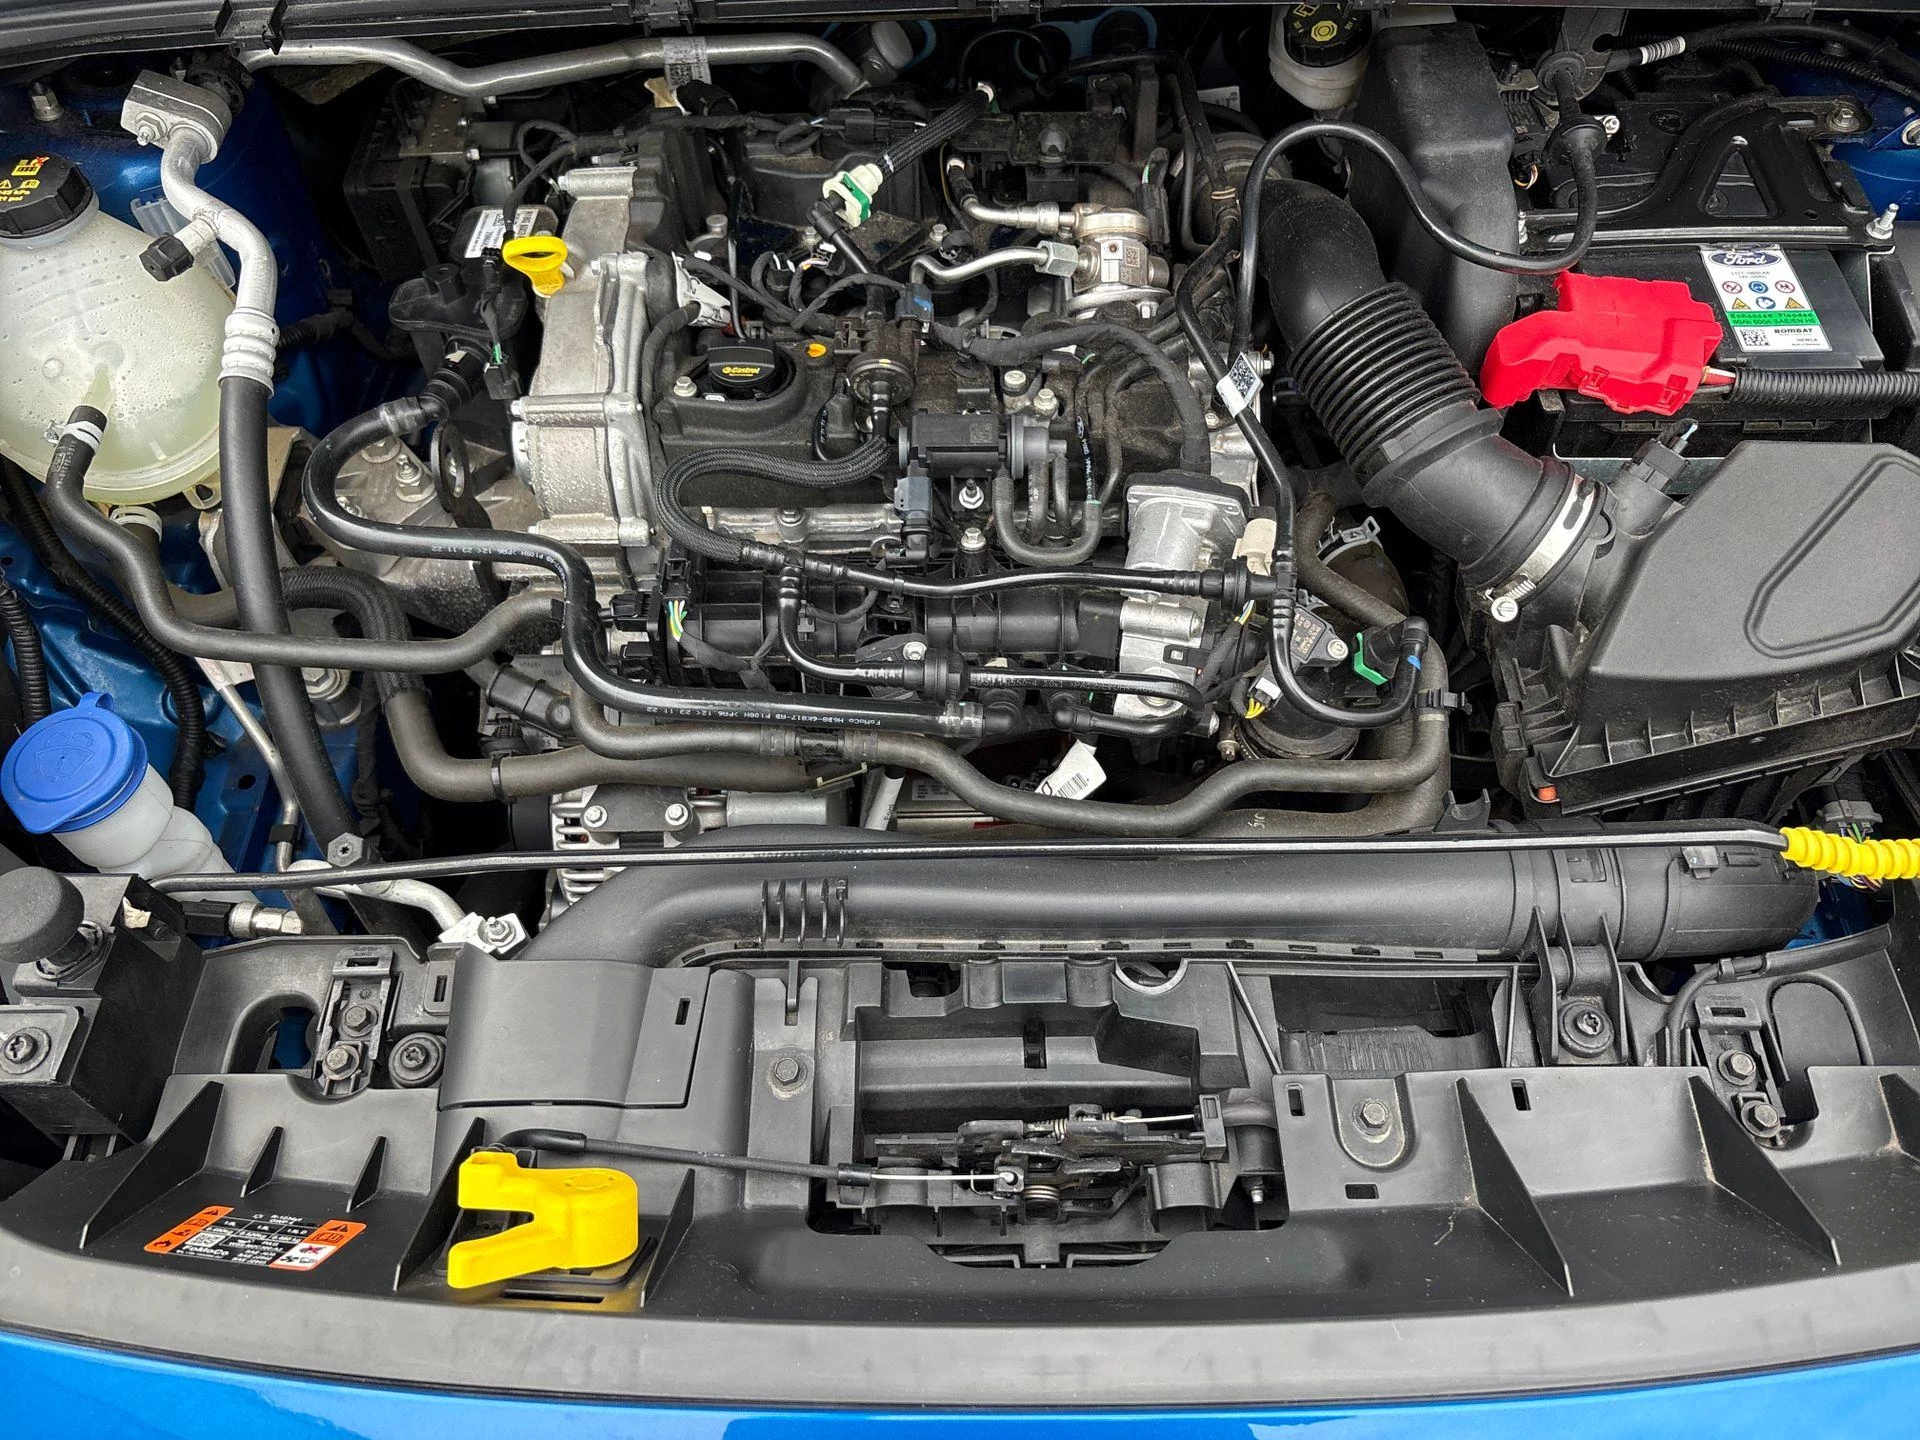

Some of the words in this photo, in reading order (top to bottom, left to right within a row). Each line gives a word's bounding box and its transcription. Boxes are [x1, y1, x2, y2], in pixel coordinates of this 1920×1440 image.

[1723, 251, 1767, 266] Ford
[731, 366, 761, 374] Castrol
[848, 717, 881, 726] FoMoCo
[182, 1245, 230, 1257] FoMoCo
